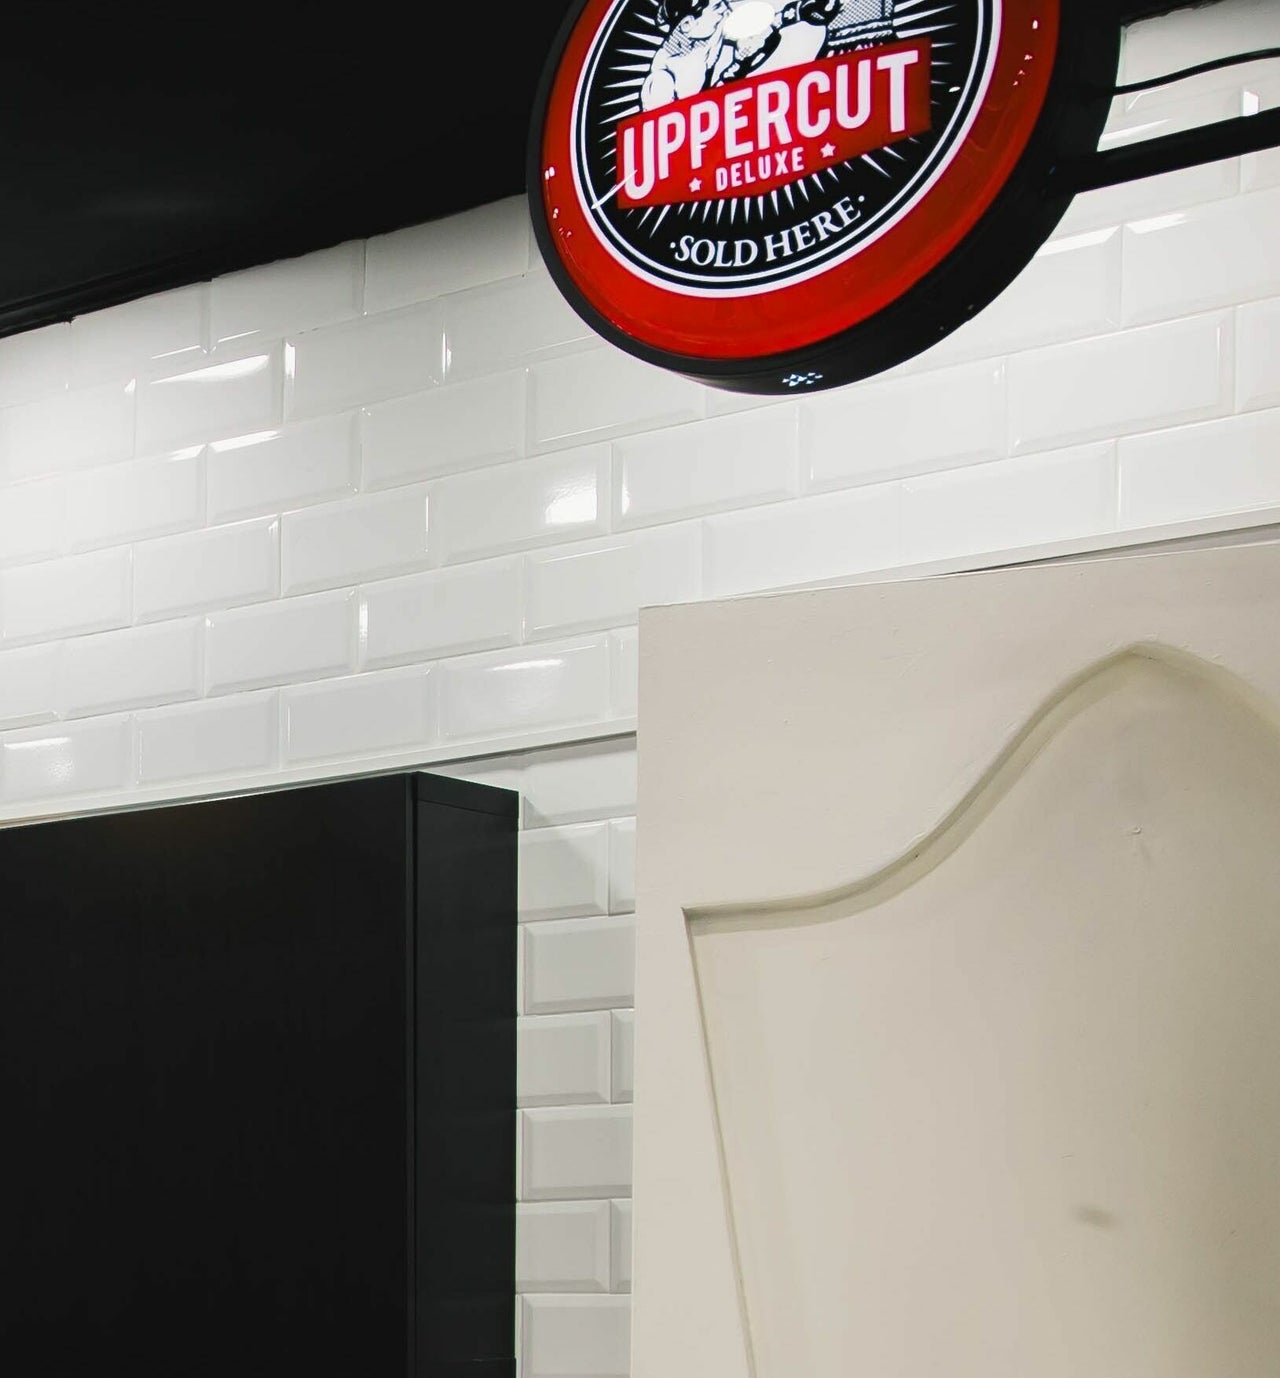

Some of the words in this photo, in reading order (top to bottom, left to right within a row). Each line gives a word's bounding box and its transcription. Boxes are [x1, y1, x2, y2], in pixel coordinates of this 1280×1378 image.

[624, 50, 919, 200] UPPERCUT
[716, 147, 804, 192] DELUXE
[674, 235, 758, 267] SOLD
[764, 196, 862, 261] HERE
